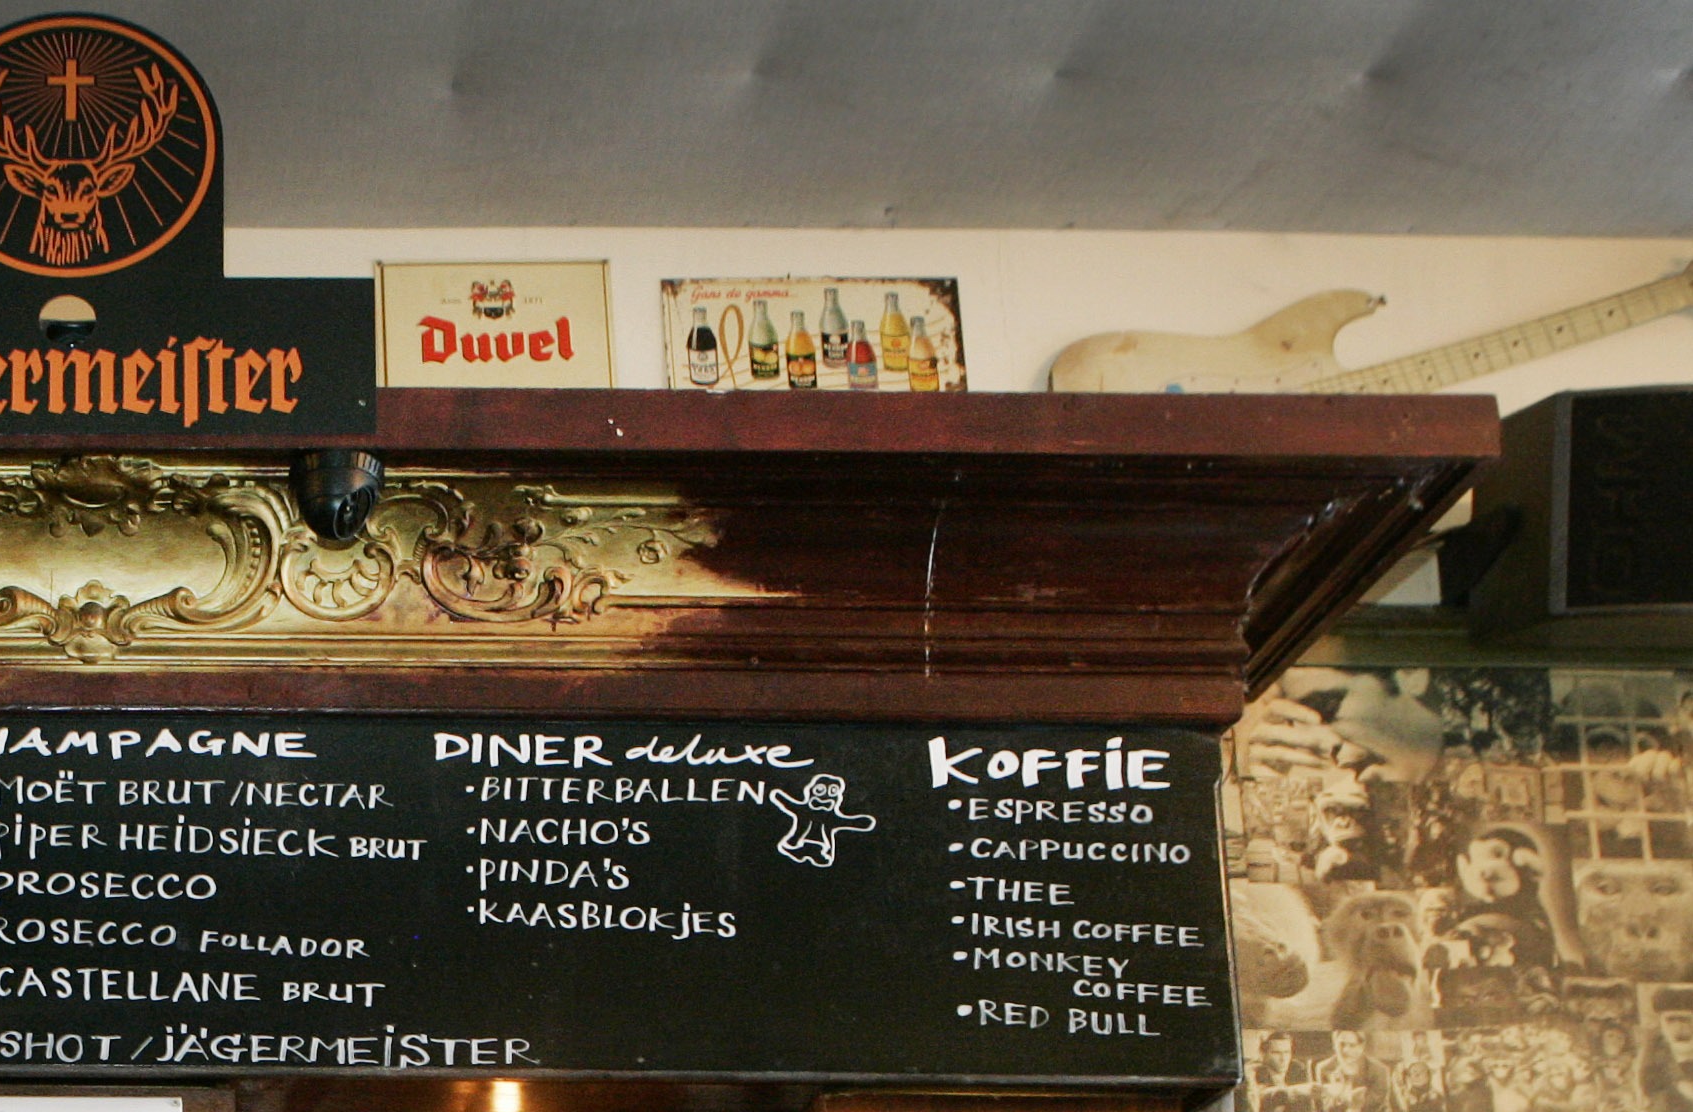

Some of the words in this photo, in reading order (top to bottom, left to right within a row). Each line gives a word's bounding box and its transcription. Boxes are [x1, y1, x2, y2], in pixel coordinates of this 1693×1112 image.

[417, 315, 575, 364] Duvel
[434, 732, 614, 768] DINER
[624, 733, 815, 768] deluxe
[928, 736, 1171, 790] KOFFIE
[119, 778, 225, 806] BRUT
[480, 775, 766, 804] BITTERBALLEN
[968, 797, 1154, 824] ESPRESSO
[119, 814, 341, 859] HEIDSIECK
[349, 836, 428, 861] BRUT
[479, 817, 652, 846] NACHO'S
[970, 837, 1192, 864] CAPPUCCINO
[479, 857, 631, 891] PINDA'S
[967, 876, 1075, 905] THEE
[478, 899, 738, 940] KAASBLOKJES
[971, 912, 1061, 938] IRISH
[1072, 919, 1205, 947] COFFEE
[199, 929, 371, 960] FOLLADOR
[973, 947, 1130, 979] MONKEY
[282, 981, 387, 1007] BRUT
[1072, 979, 1213, 1007] COFFEE
[978, 999, 1051, 1029] RED
[1067, 1007, 1162, 1036] BULL
